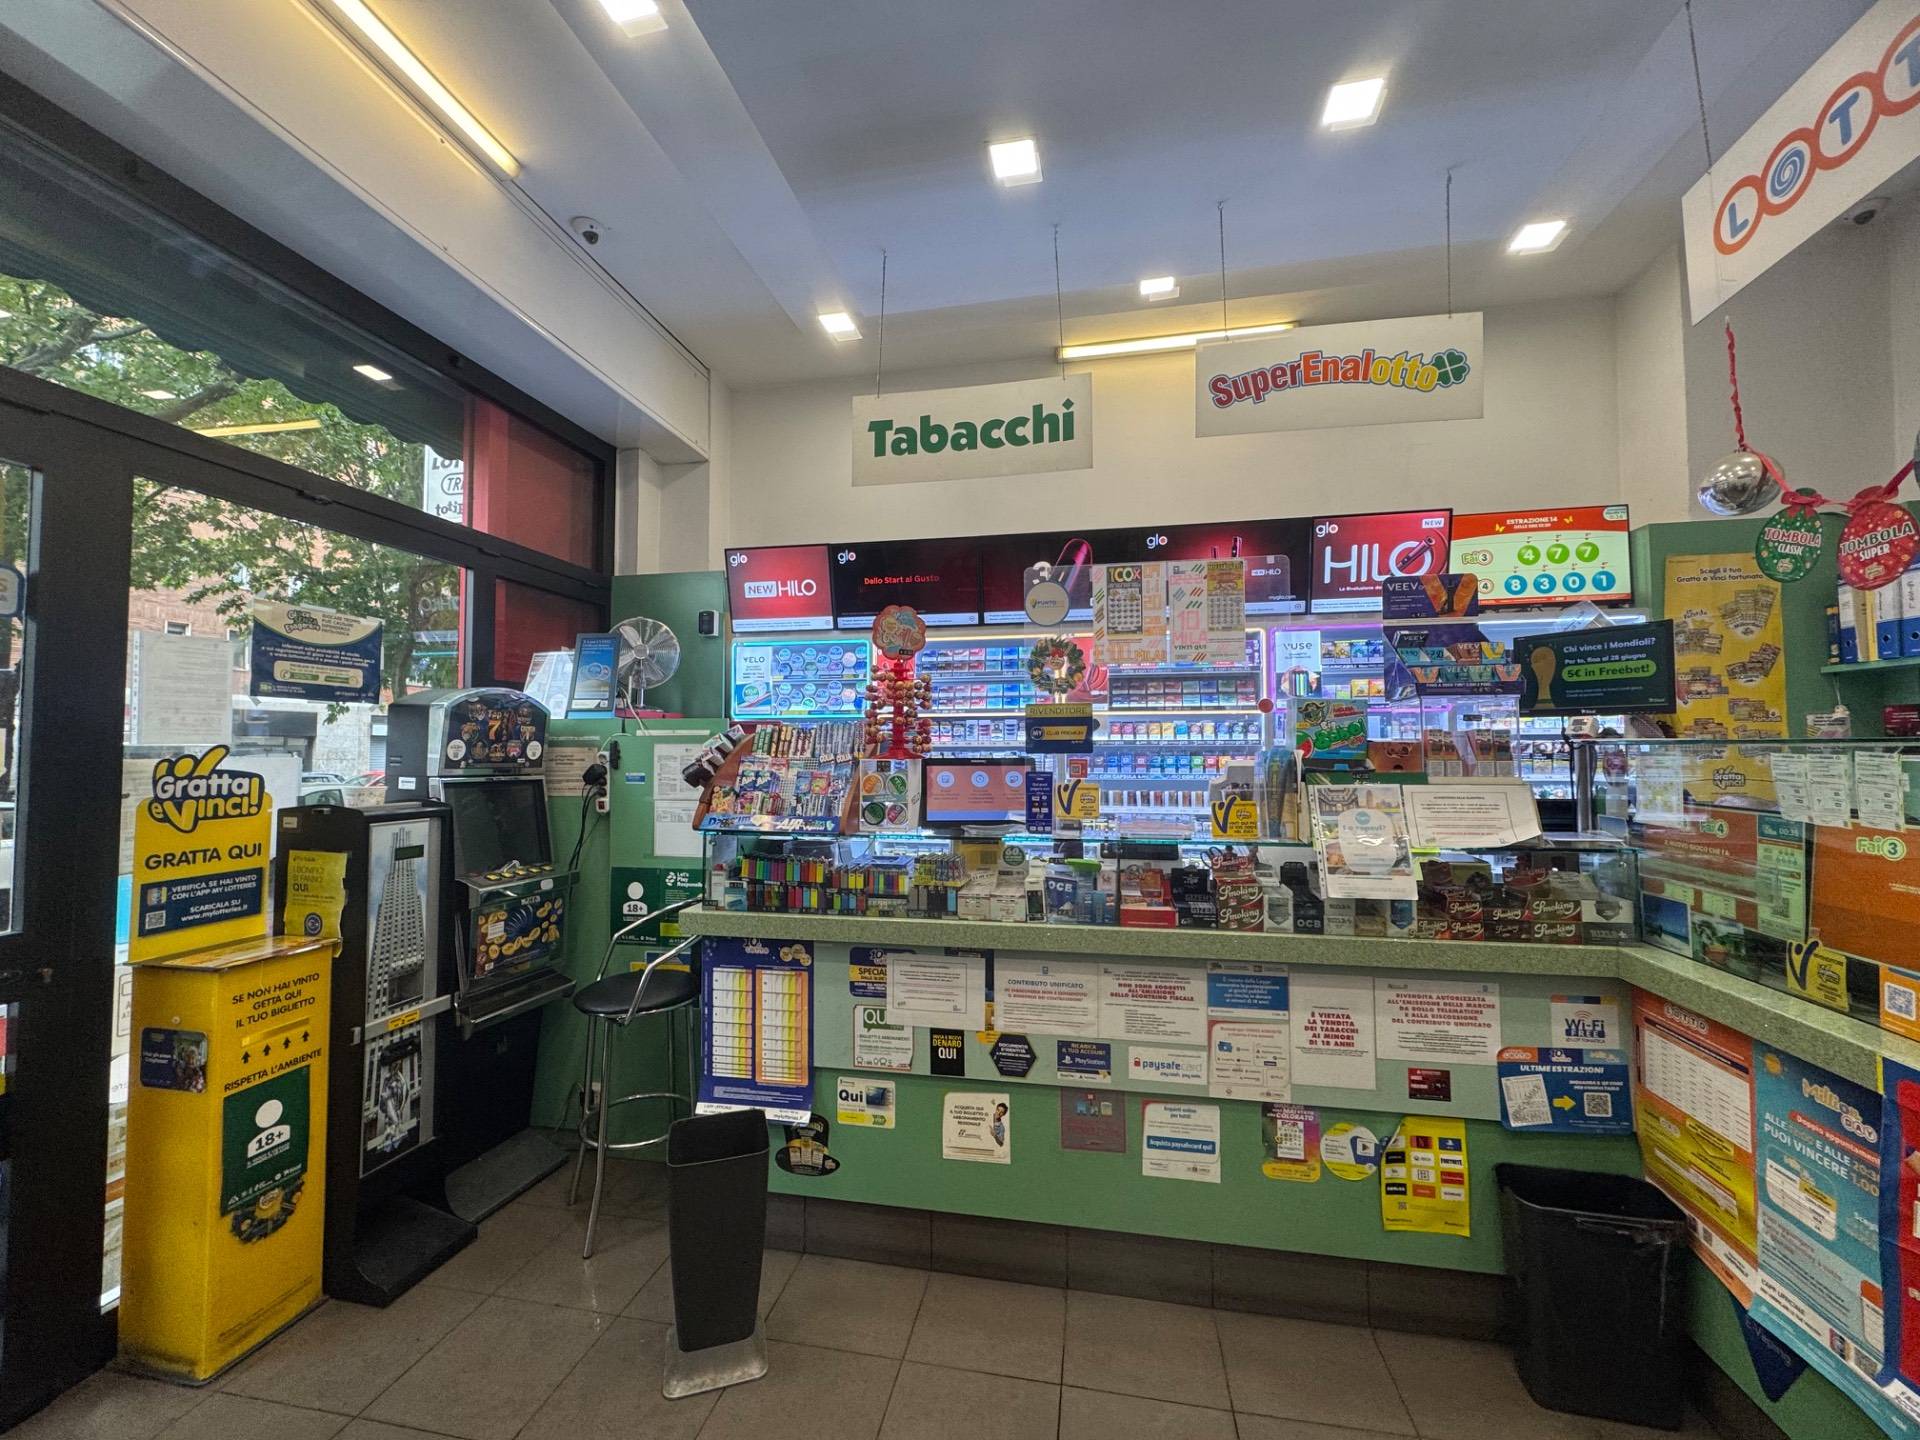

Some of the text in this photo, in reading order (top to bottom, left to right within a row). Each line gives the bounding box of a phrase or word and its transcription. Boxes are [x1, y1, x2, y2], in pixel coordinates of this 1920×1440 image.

[1210, 349, 1439, 409] SuperEnalotto
[868, 398, 1074, 458] Tabacchi
[1316, 522, 1338, 537] glo
[1424, 519, 1442, 530] NEW
[1146, 534, 1167, 549] glo
[1765, 527, 1822, 546] TOMBOLA
[1840, 521, 1915, 554] TOMBOLA
[1523, 545, 1591, 561] 4 7 7
[1778, 544, 1804, 556] CLASSIC
[1859, 543, 1890, 562] SUPER
[730, 552, 748, 567] glo
[838, 550, 856, 565] glo
[1324, 541, 1432, 584] HILO
[1264, 568, 1281, 577] HILO
[1700, 567, 1722, 575] Scegli
[864, 576, 883, 585] Dallo
[884, 576, 904, 584] Start
[914, 574, 939, 583] Gusto
[1511, 576, 1607, 591] 8 3 0 1
[748, 579, 817, 597] NEW HILO
[1387, 582, 1417, 592] VEEV
[1178, 610, 1200, 630] 10
[1173, 631, 1207, 643] MILA
[1563, 645, 1577, 653] Chi
[1579, 644, 1602, 652] vince
[1610, 638, 1656, 649] Mondiali?
[1620, 653, 1646, 663] giugno
[1567, 664, 1650, 678] 5€ in Freebet!
[1030, 706, 1088, 715] RIVENDITORE
[487, 719, 502, 740] 7
[156, 774, 250, 801] Gratta
[162, 776, 260, 833] Vinci!
[1717, 824, 1724, 833] 4
[1857, 836, 1898, 855] Fai 3
[144, 842, 262, 871] GRATTA QUI
[171, 874, 257, 895] VERIFICA SE HAI VINTO
[171, 881, 256, 901] CON L'APP MY LOTTERIES
[1048, 879, 1073, 892] OCB
[1219, 884, 1259, 900] Smoking
[190, 898, 240, 913] SCARICALA SU
[626, 904, 644, 912] 18+
[1450, 900, 1480, 912] Smoking
[1533, 901, 1575, 914] Smoking
[181, 904, 248, 922] www.mylotteries.it
[1220, 908, 1260, 923] Smoking
[1493, 907, 1521, 919] Smoking
[1297, 918, 1321, 927] OCB
[1452, 921, 1481, 933] Smoking
[1534, 923, 1575, 937] Smoking
[233, 973, 319, 1004] SE NON HAI VINTO
[1007, 979, 1083, 989] CONTRIBUTO UNIFICATO
[1154, 983, 1186, 991] SOGGETTI
[253, 989, 302, 1011] GETTA QUI
[1131, 992, 1167, 1000] SCONTRINO
[1386, 999, 1441, 1007] ALL'EMISSIONE
[1435, 994, 1486, 1002] AUTORIZZATA
[236, 996, 316, 1028] IL TUO BIGLIETTO
[1318, 1012, 1351, 1020] VIETATA
[1436, 1007, 1484, 1015] TELEMATICHE
[1320, 1019, 1355, 1027] VENDITA
[1406, 1019, 1452, 1027] CONTRIBUTO
[1453, 1020, 1492, 1029] UNIFICATO
[1565, 1018, 1605, 1031] Wi-Fi
[1664, 1003, 1709, 1035] LOTTO
[1320, 1026, 1359, 1034] TABACCHI
[1323, 1032, 1354, 1040] MINORI
[1572, 1030, 1599, 1038] FREE
[932, 1039, 962, 1048] DENARO
[1333, 1040, 1355, 1048] ANNI
[938, 1047, 957, 1059] QUI
[1075, 1057, 1106, 1066] PlayStation
[1142, 1059, 1202, 1073] paysafecard
[225, 1048, 323, 1093] RISPETTA L'AMBIENTE
[1520, 1065, 1605, 1074] ULTIME ESTRAZIONI
[838, 1089, 864, 1104] Qui
[1276, 1112, 1314, 1121] COLORATO
[256, 1130, 284, 1153] 18+
[1765, 1112, 1850, 1166] ALLE E ALLE
[1764, 1123, 1848, 1180] PUOI VINCERE
